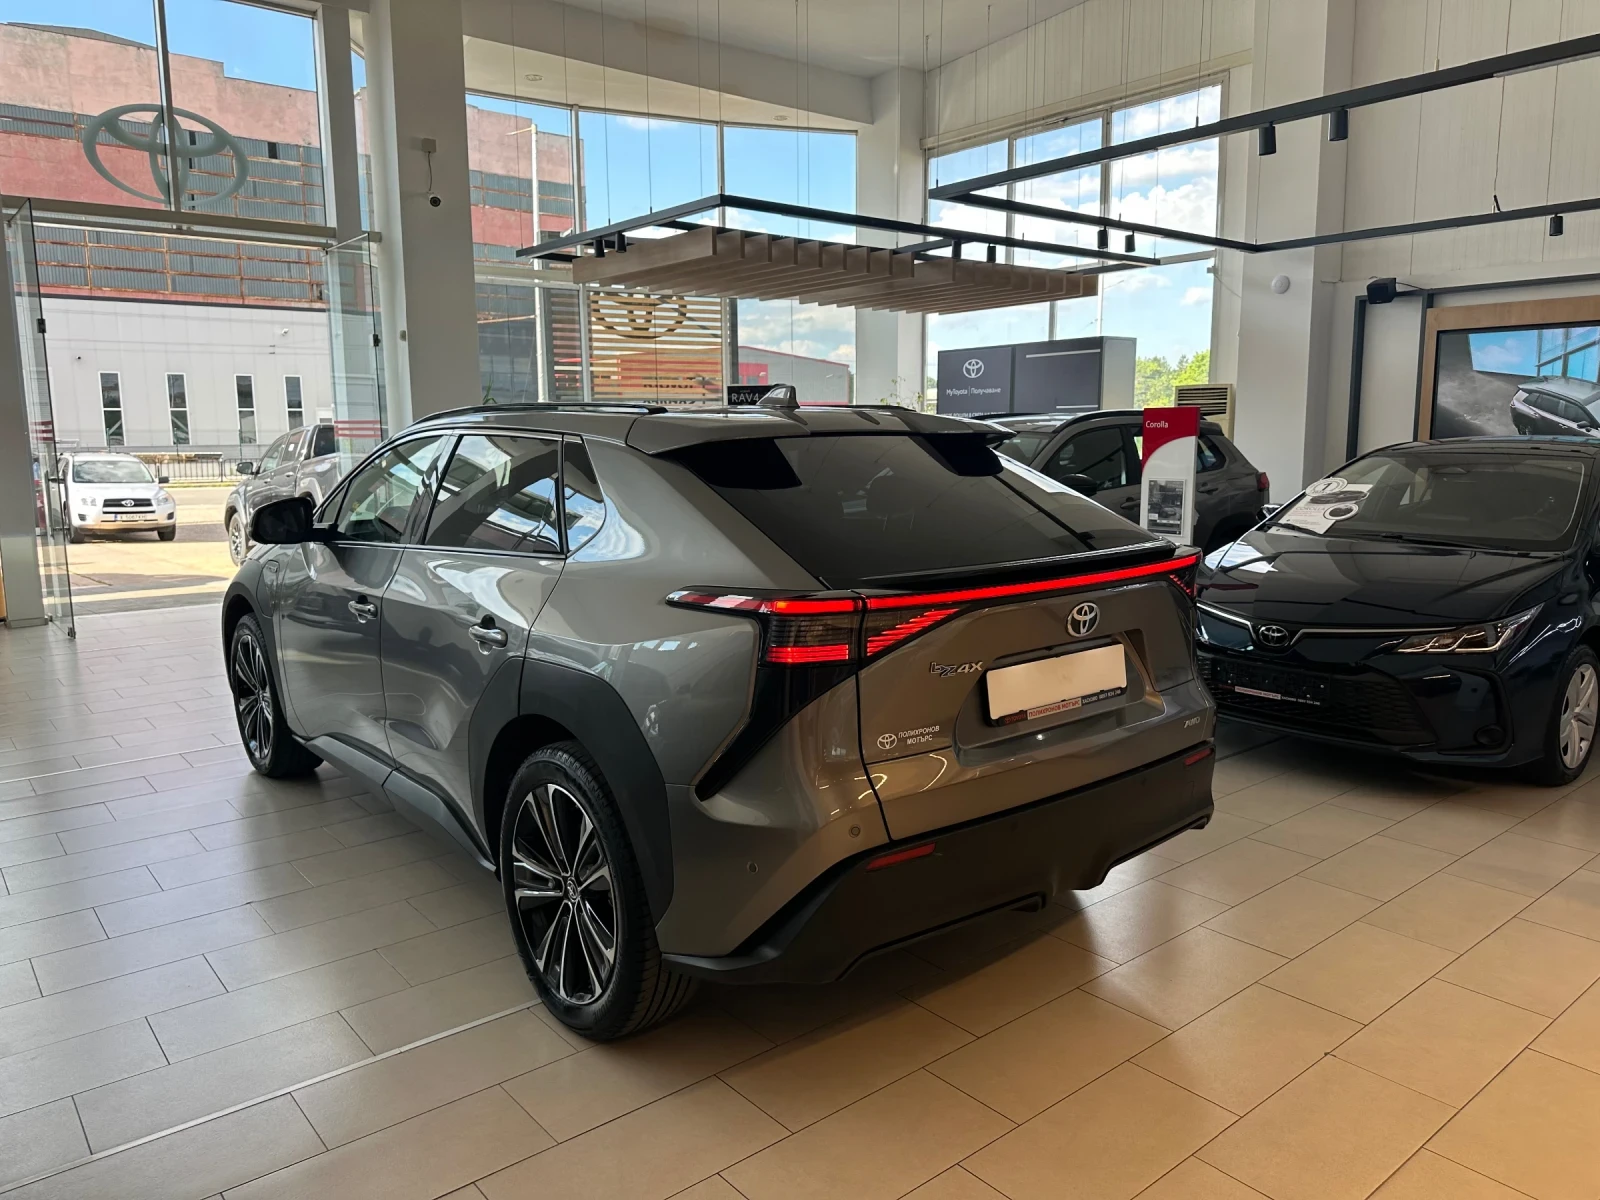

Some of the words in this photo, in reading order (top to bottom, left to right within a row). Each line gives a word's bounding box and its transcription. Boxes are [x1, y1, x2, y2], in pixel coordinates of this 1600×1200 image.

[731, 392, 759, 403] RAV4
[946, 388, 968, 397] MyToyota
[970, 387, 1002, 396] Получаване
[1145, 420, 1169, 429] Corolla
[1028, 705, 1062, 718] ПОЛИХРОНОВ
[1061, 699, 1081, 710] МОТЪРС
[898, 725, 940, 739] ПОЛИХРОНОВ
[906, 734, 933, 745] МОТЪРС
